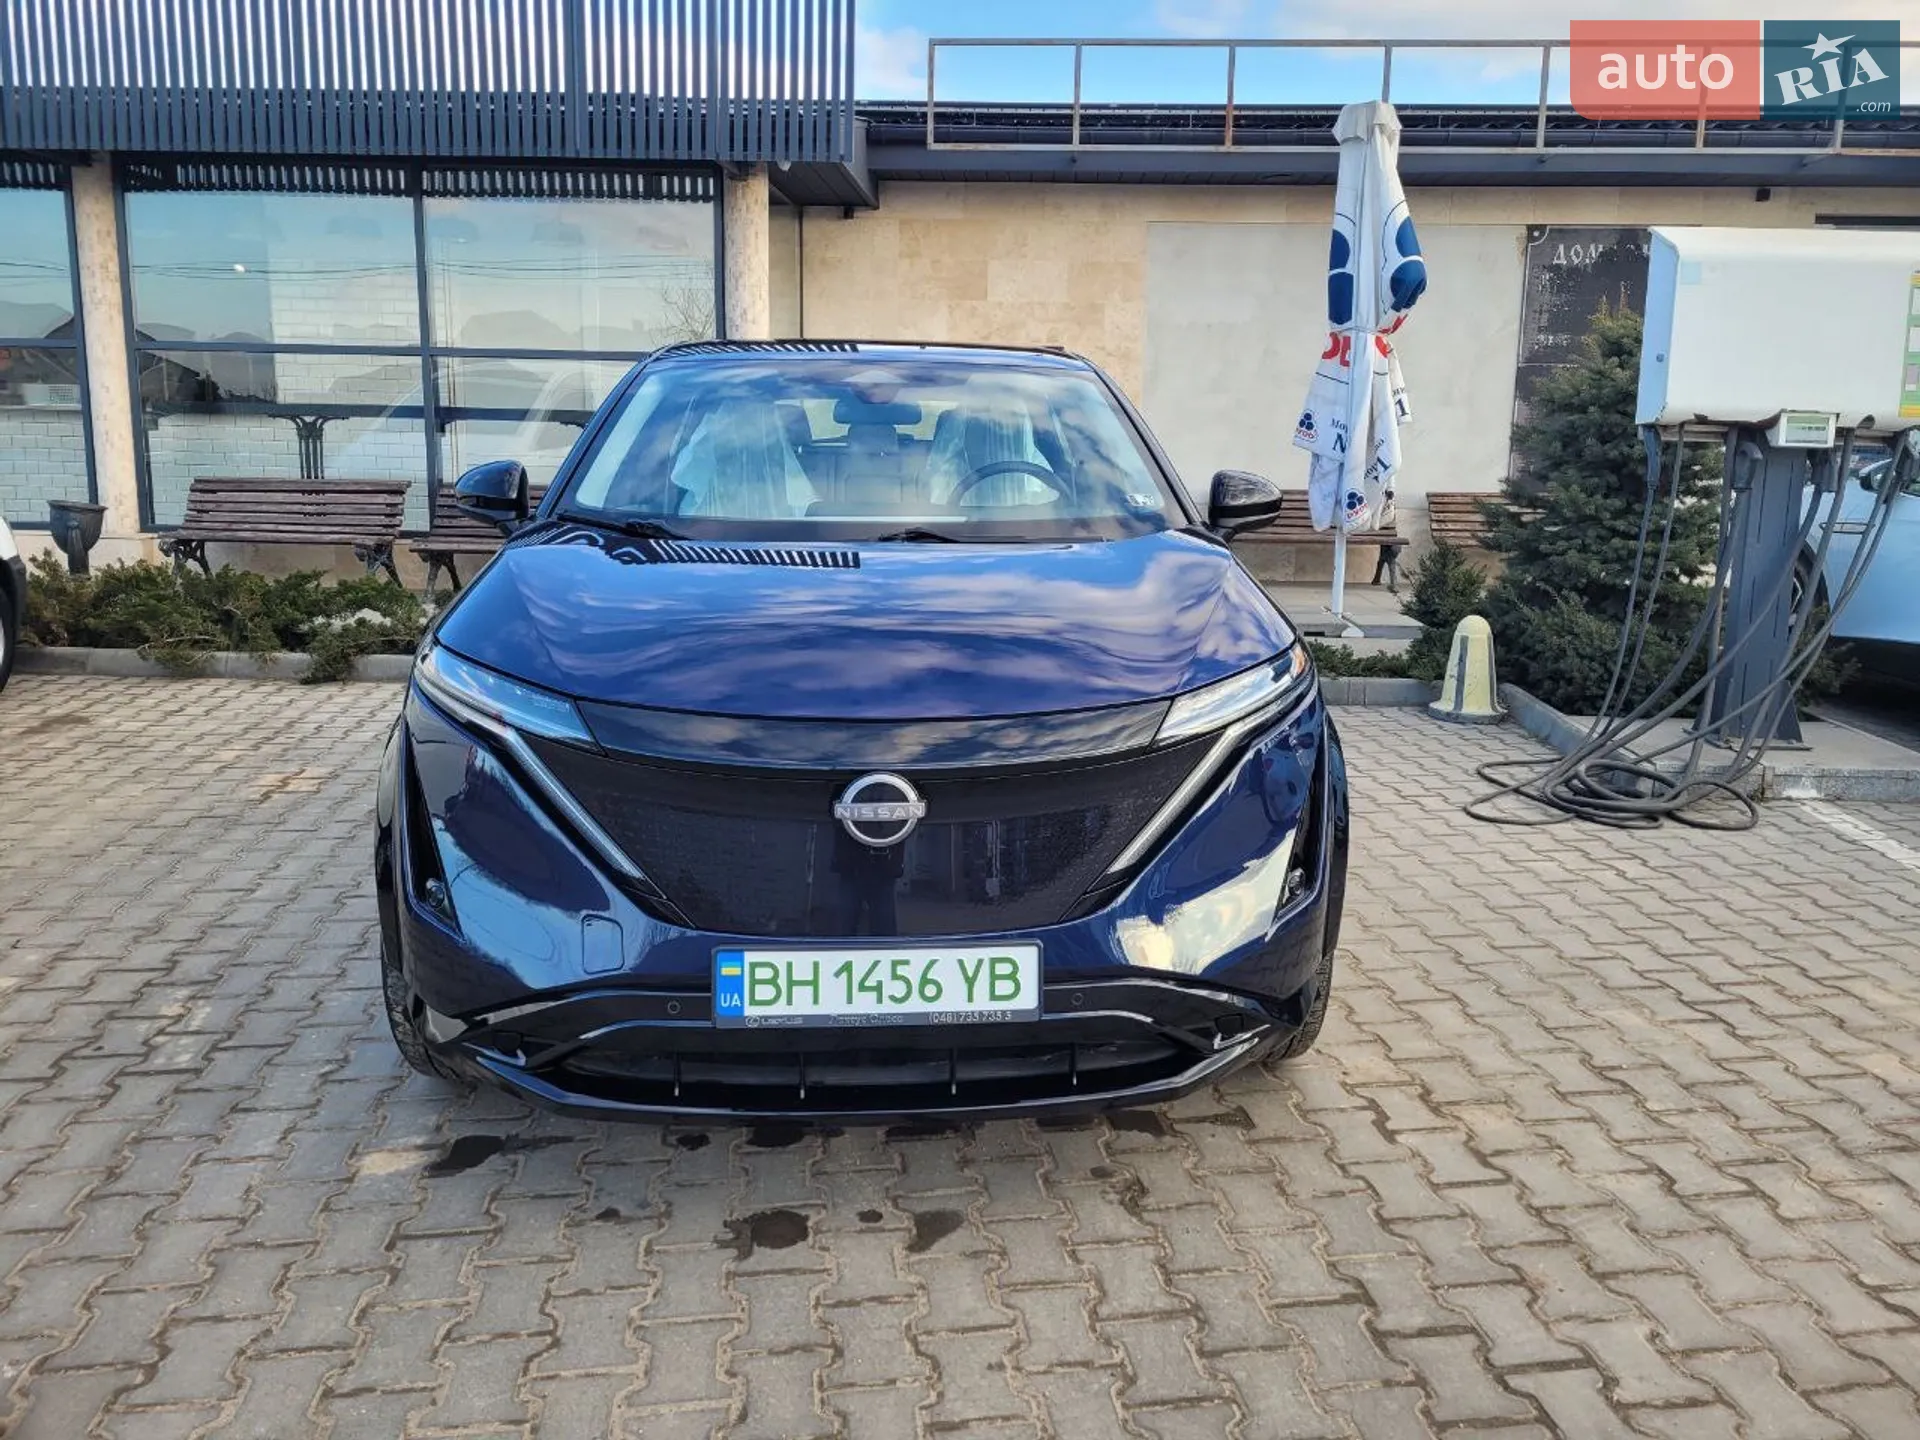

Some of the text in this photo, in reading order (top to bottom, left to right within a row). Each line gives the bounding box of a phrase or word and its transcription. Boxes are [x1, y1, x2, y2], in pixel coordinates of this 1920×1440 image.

[835, 805, 923, 819] NISSAN
[748, 956, 1022, 1007] BH 1456 YB
[720, 992, 742, 1008] UA
